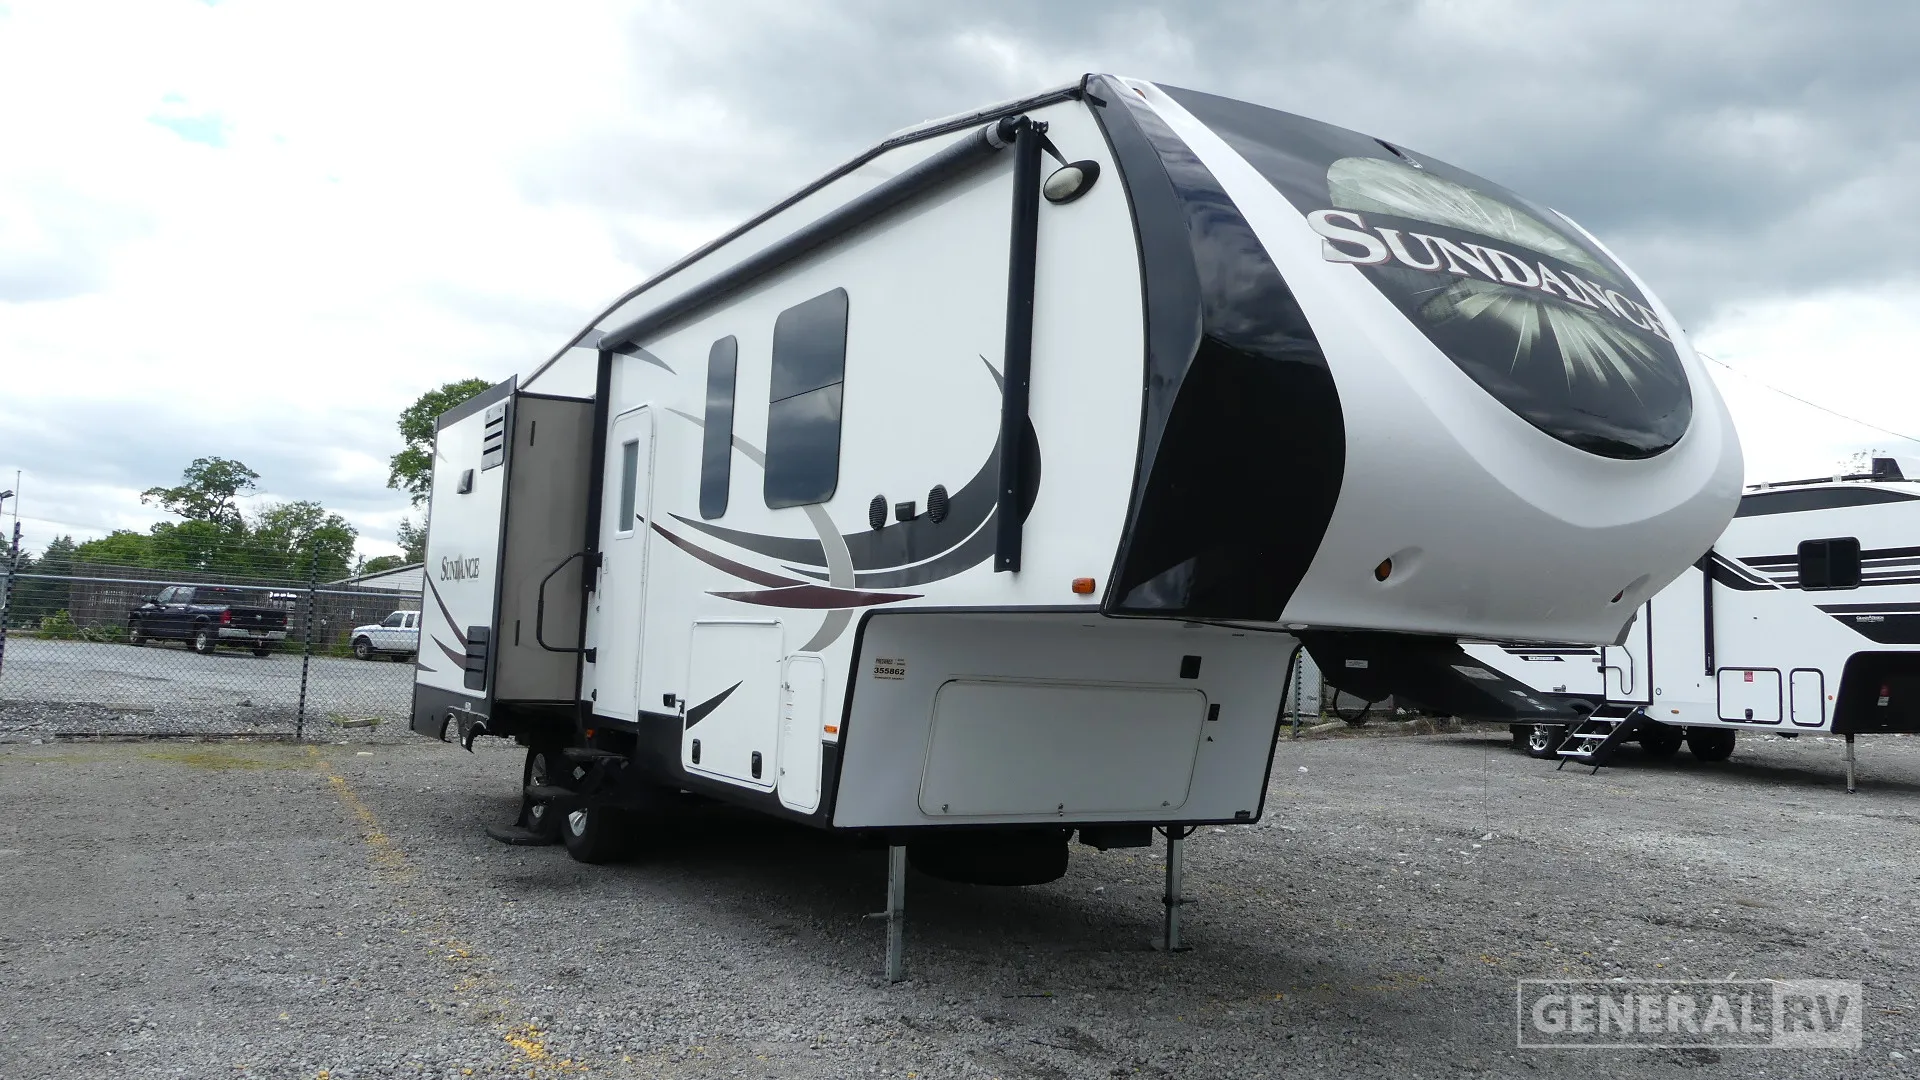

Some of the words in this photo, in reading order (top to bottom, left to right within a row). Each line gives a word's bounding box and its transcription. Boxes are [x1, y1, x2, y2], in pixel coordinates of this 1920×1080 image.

[1307, 208, 1672, 342] SUNDANCE
[440, 555, 480, 581] SUNDANCE
[873, 667, 905, 675] 355862
